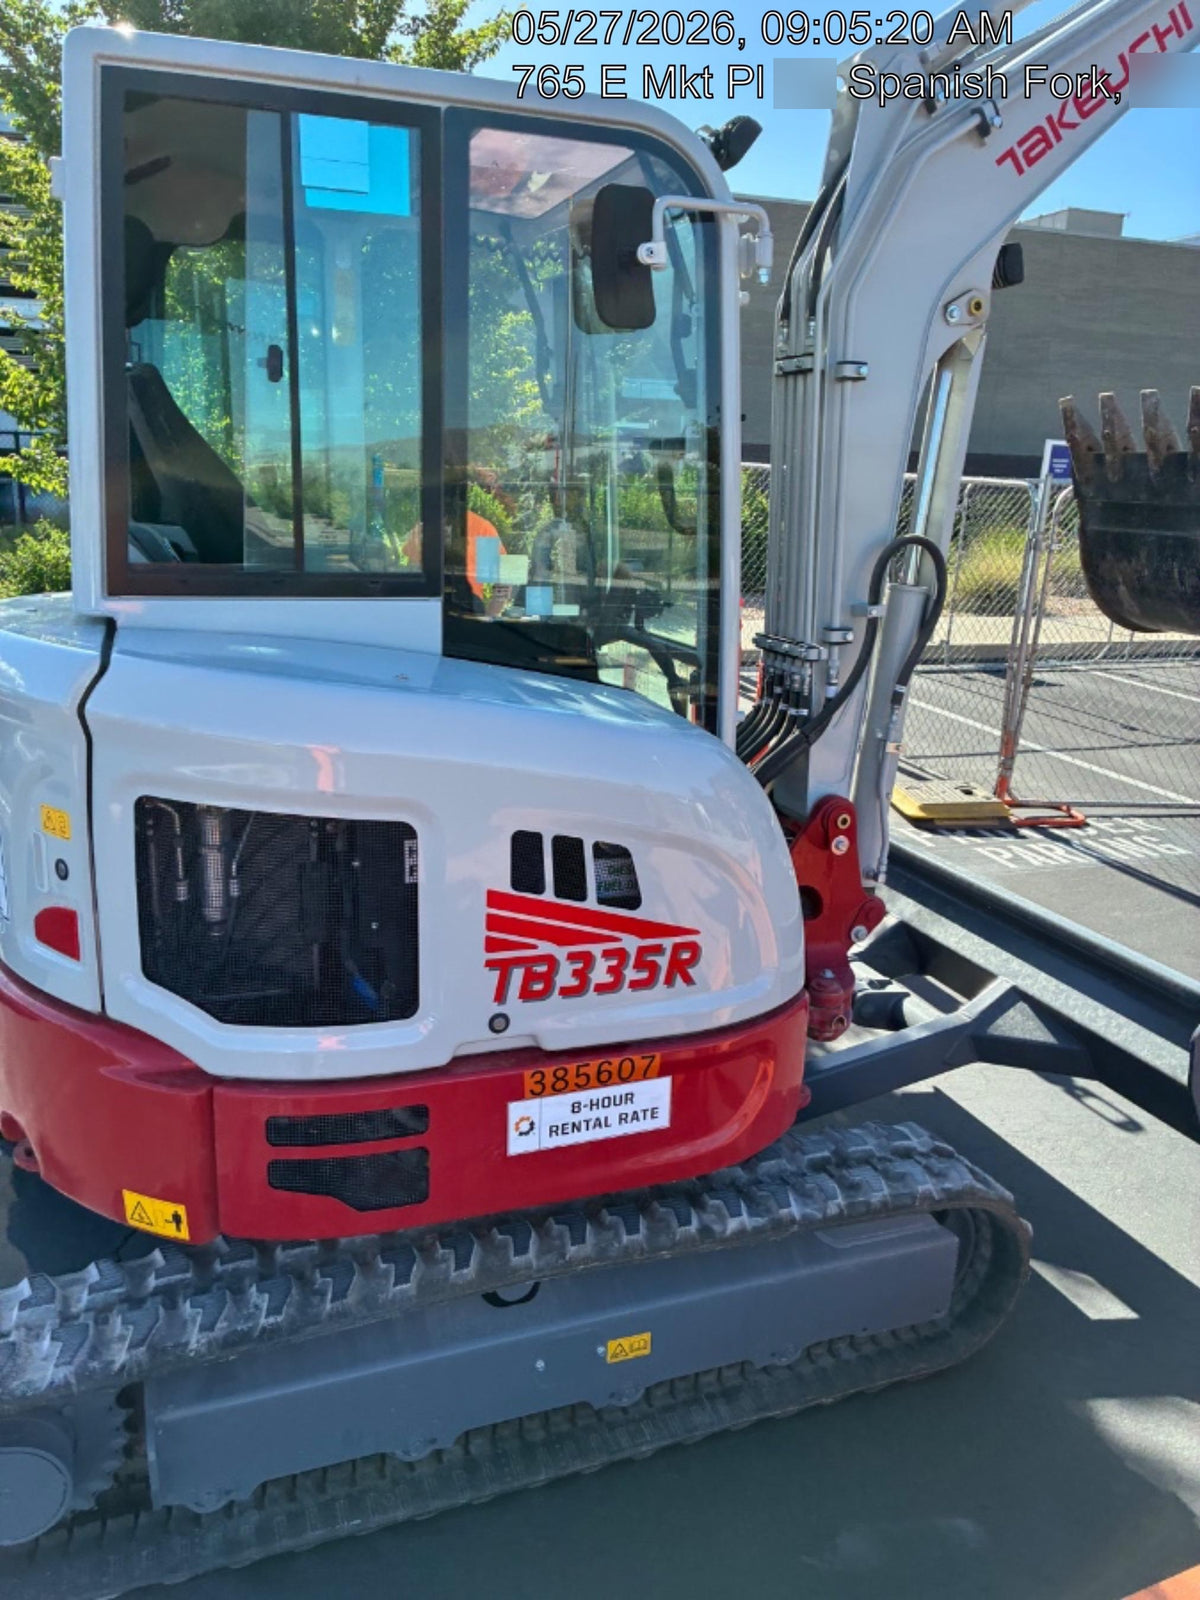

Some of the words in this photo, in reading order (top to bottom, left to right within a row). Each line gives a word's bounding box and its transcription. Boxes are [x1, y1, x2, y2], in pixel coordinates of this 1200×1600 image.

[974, 835, 1192, 869] PARKING
[484, 941, 703, 1005] TB335R
[528, 1054, 657, 1097] 385607
[570, 1092, 635, 1114] 8-HOUR
[548, 1116, 612, 1138] RENTAL
[618, 1107, 660, 1126] RATE
